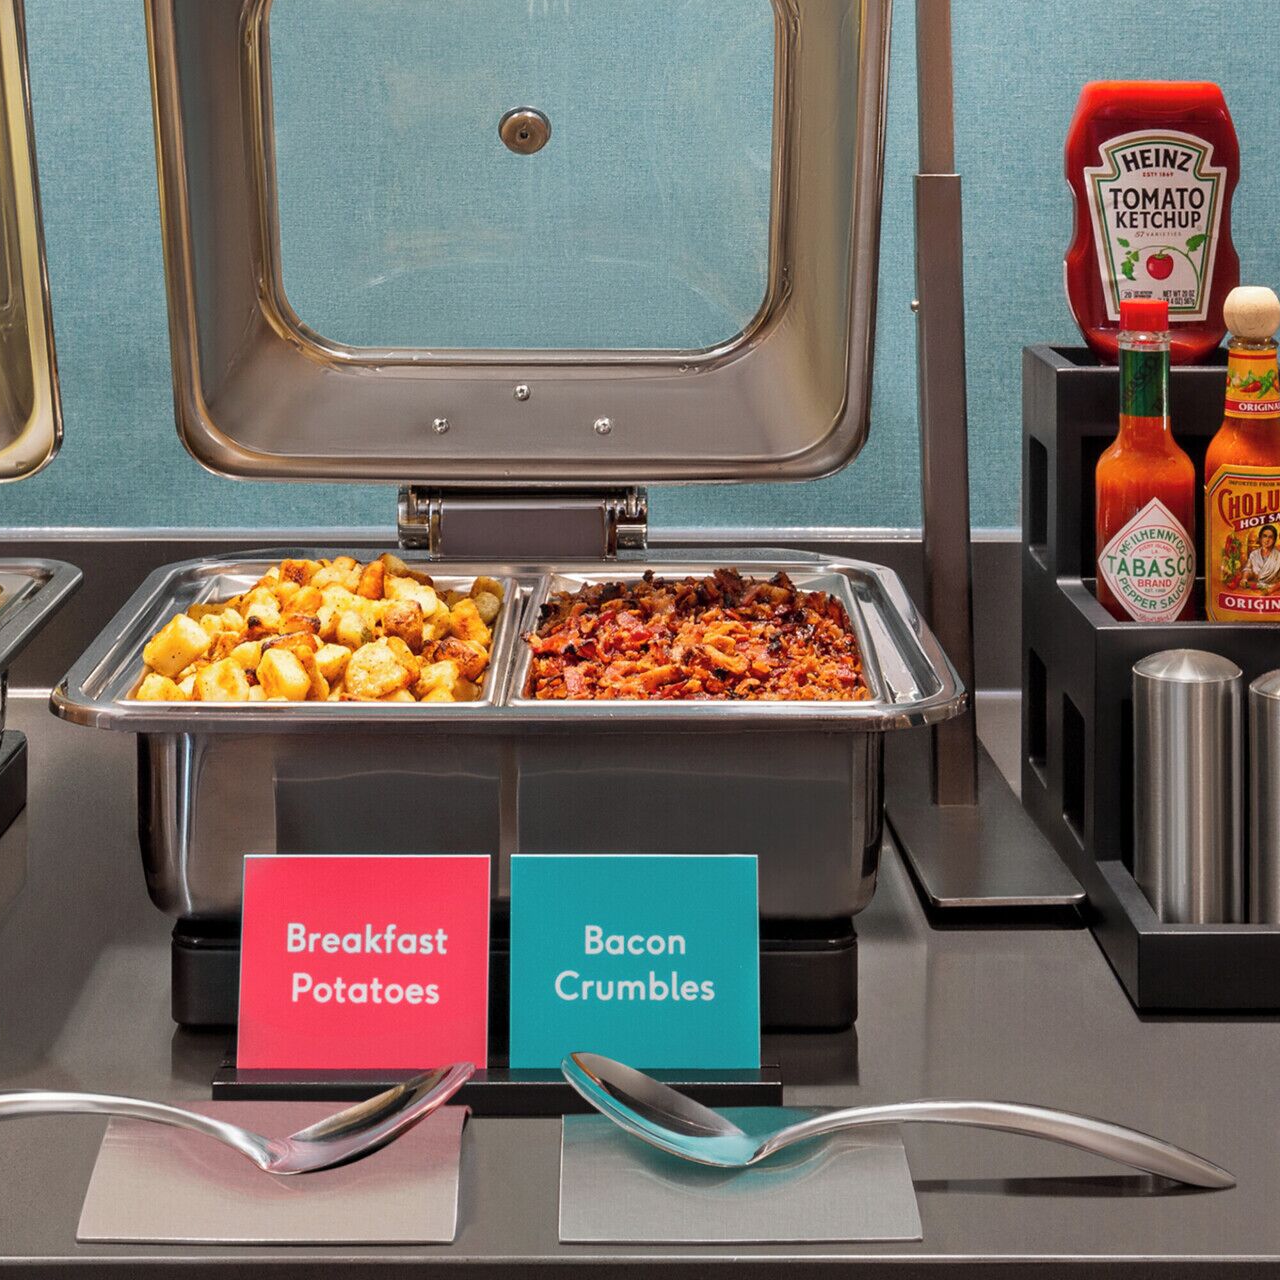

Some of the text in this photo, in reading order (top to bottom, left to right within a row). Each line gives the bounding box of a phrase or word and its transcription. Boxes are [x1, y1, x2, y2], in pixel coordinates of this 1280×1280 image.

[1121, 148, 1193, 172] HEINZ
[1109, 187, 1205, 210] TOMATO
[1116, 210, 1201, 229] KETCHUP
[1240, 515, 1266, 529] HOT
[1107, 553, 1193, 578] TABASCO
[1119, 577, 1187, 609] PEPPER SAUCE
[1137, 579, 1172, 588] BRAND
[286, 922, 448, 955] Breakfast
[584, 925, 686, 955] Bacon
[291, 972, 440, 1005] Potatoes
[554, 970, 715, 1001] Crumbles
